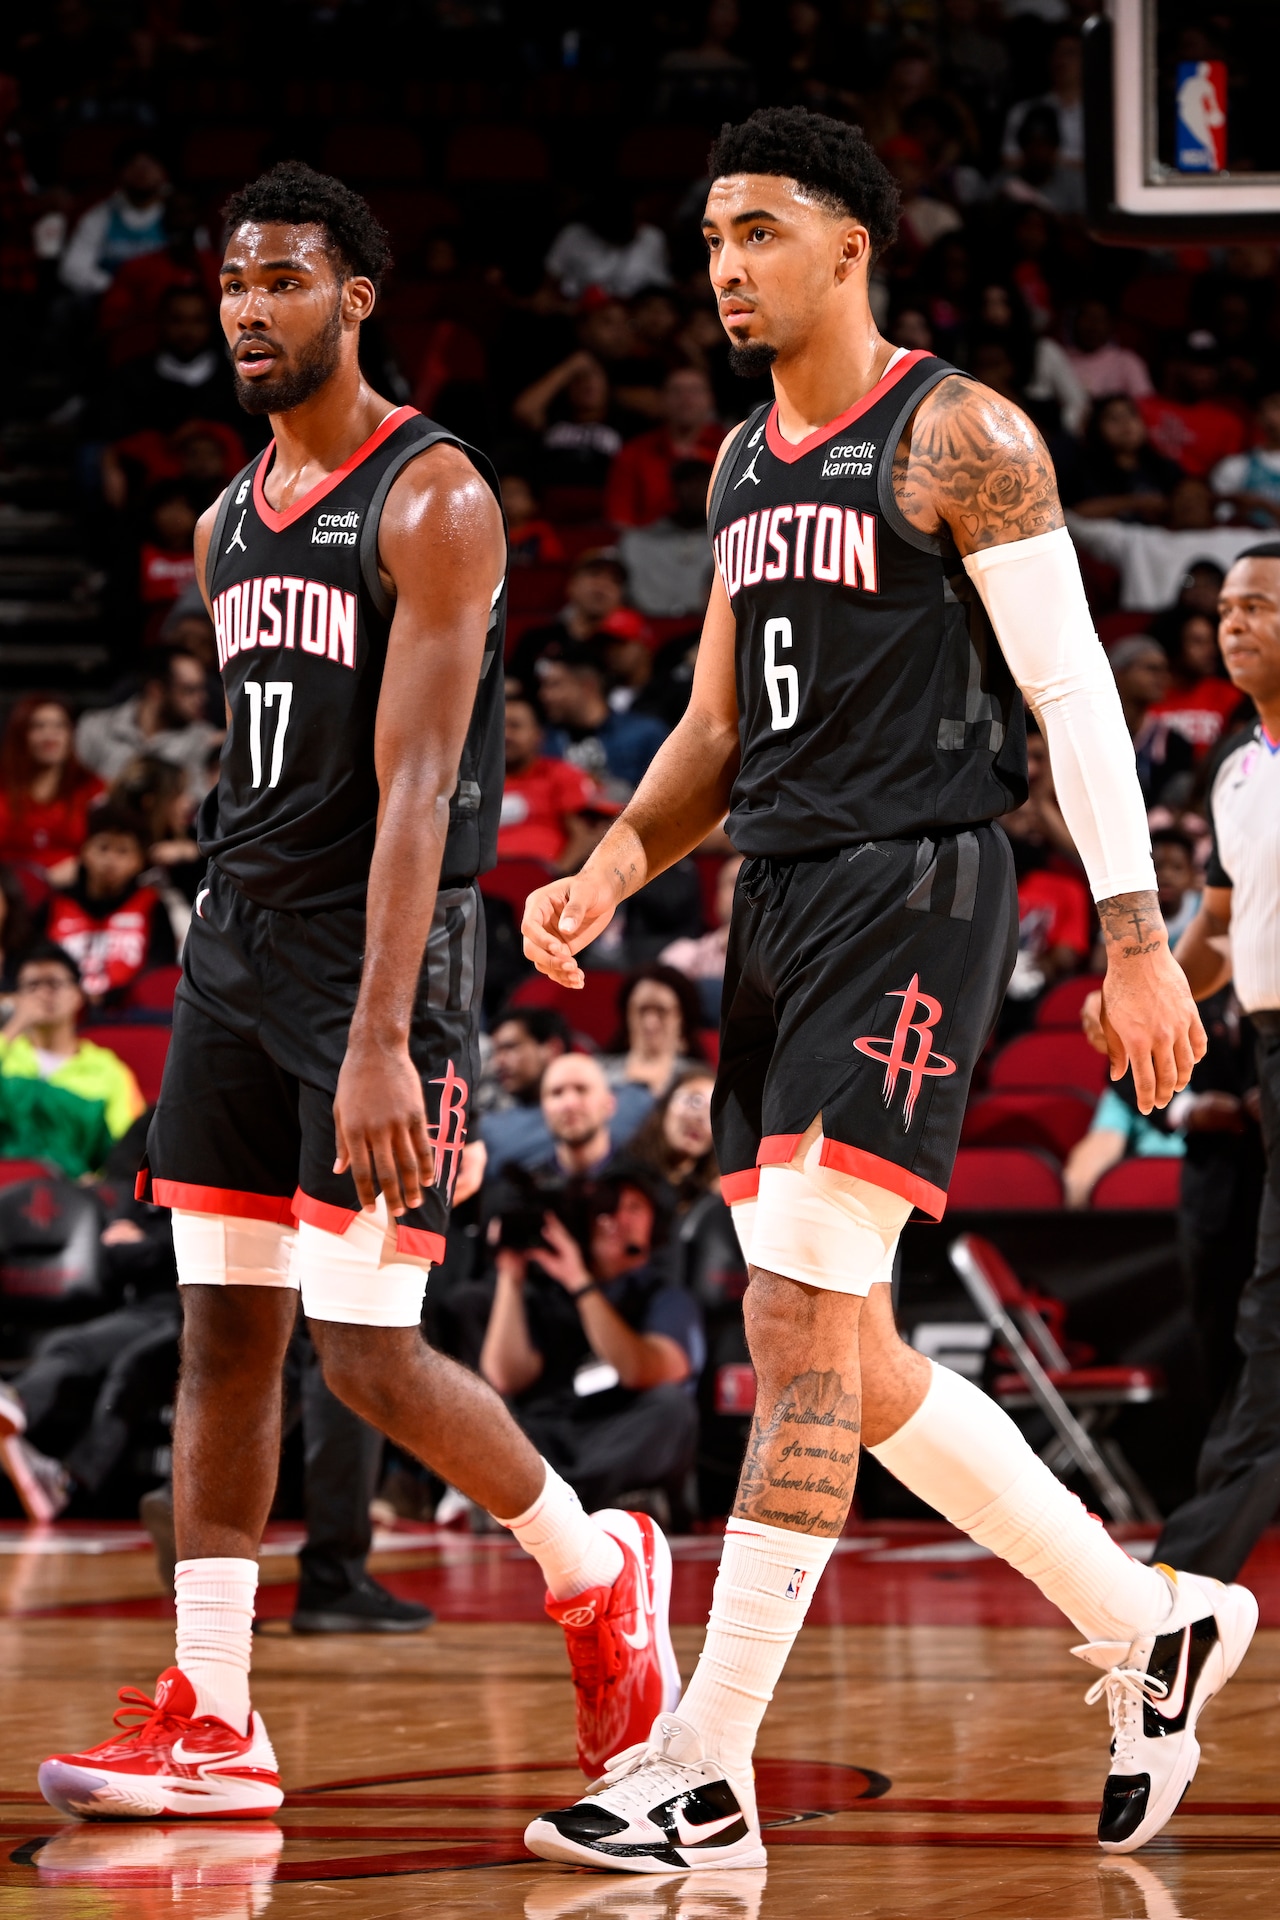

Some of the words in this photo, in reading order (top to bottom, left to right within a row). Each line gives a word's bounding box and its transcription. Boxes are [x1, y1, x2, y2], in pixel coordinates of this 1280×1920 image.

[747, 423, 766, 448] 6
[829, 442, 876, 459] credit
[821, 460, 873, 476] karma
[235, 479, 251, 504] 6
[317, 511, 360, 528] credit
[311, 527, 357, 545] karma
[714, 503, 878, 602] HOUSTON
[212, 575, 358, 672] HOUSTON
[764, 616, 799, 731] 6
[244, 681, 293, 788] 17
[772, 1401, 796, 1423] The
[795, 1407, 836, 1426] ultimate
[777, 1440, 799, 1462] of
[793, 1446, 803, 1457] a
[804, 1447, 829, 1459] man
[829, 1448, 839, 1462] is
[838, 1450, 855, 1466] not
[770, 1471, 803, 1490] where
[800, 1473, 815, 1491] he
[814, 1476, 844, 1499] stands
[760, 1509, 810, 1526] moments
[803, 1510, 823, 1533] of
